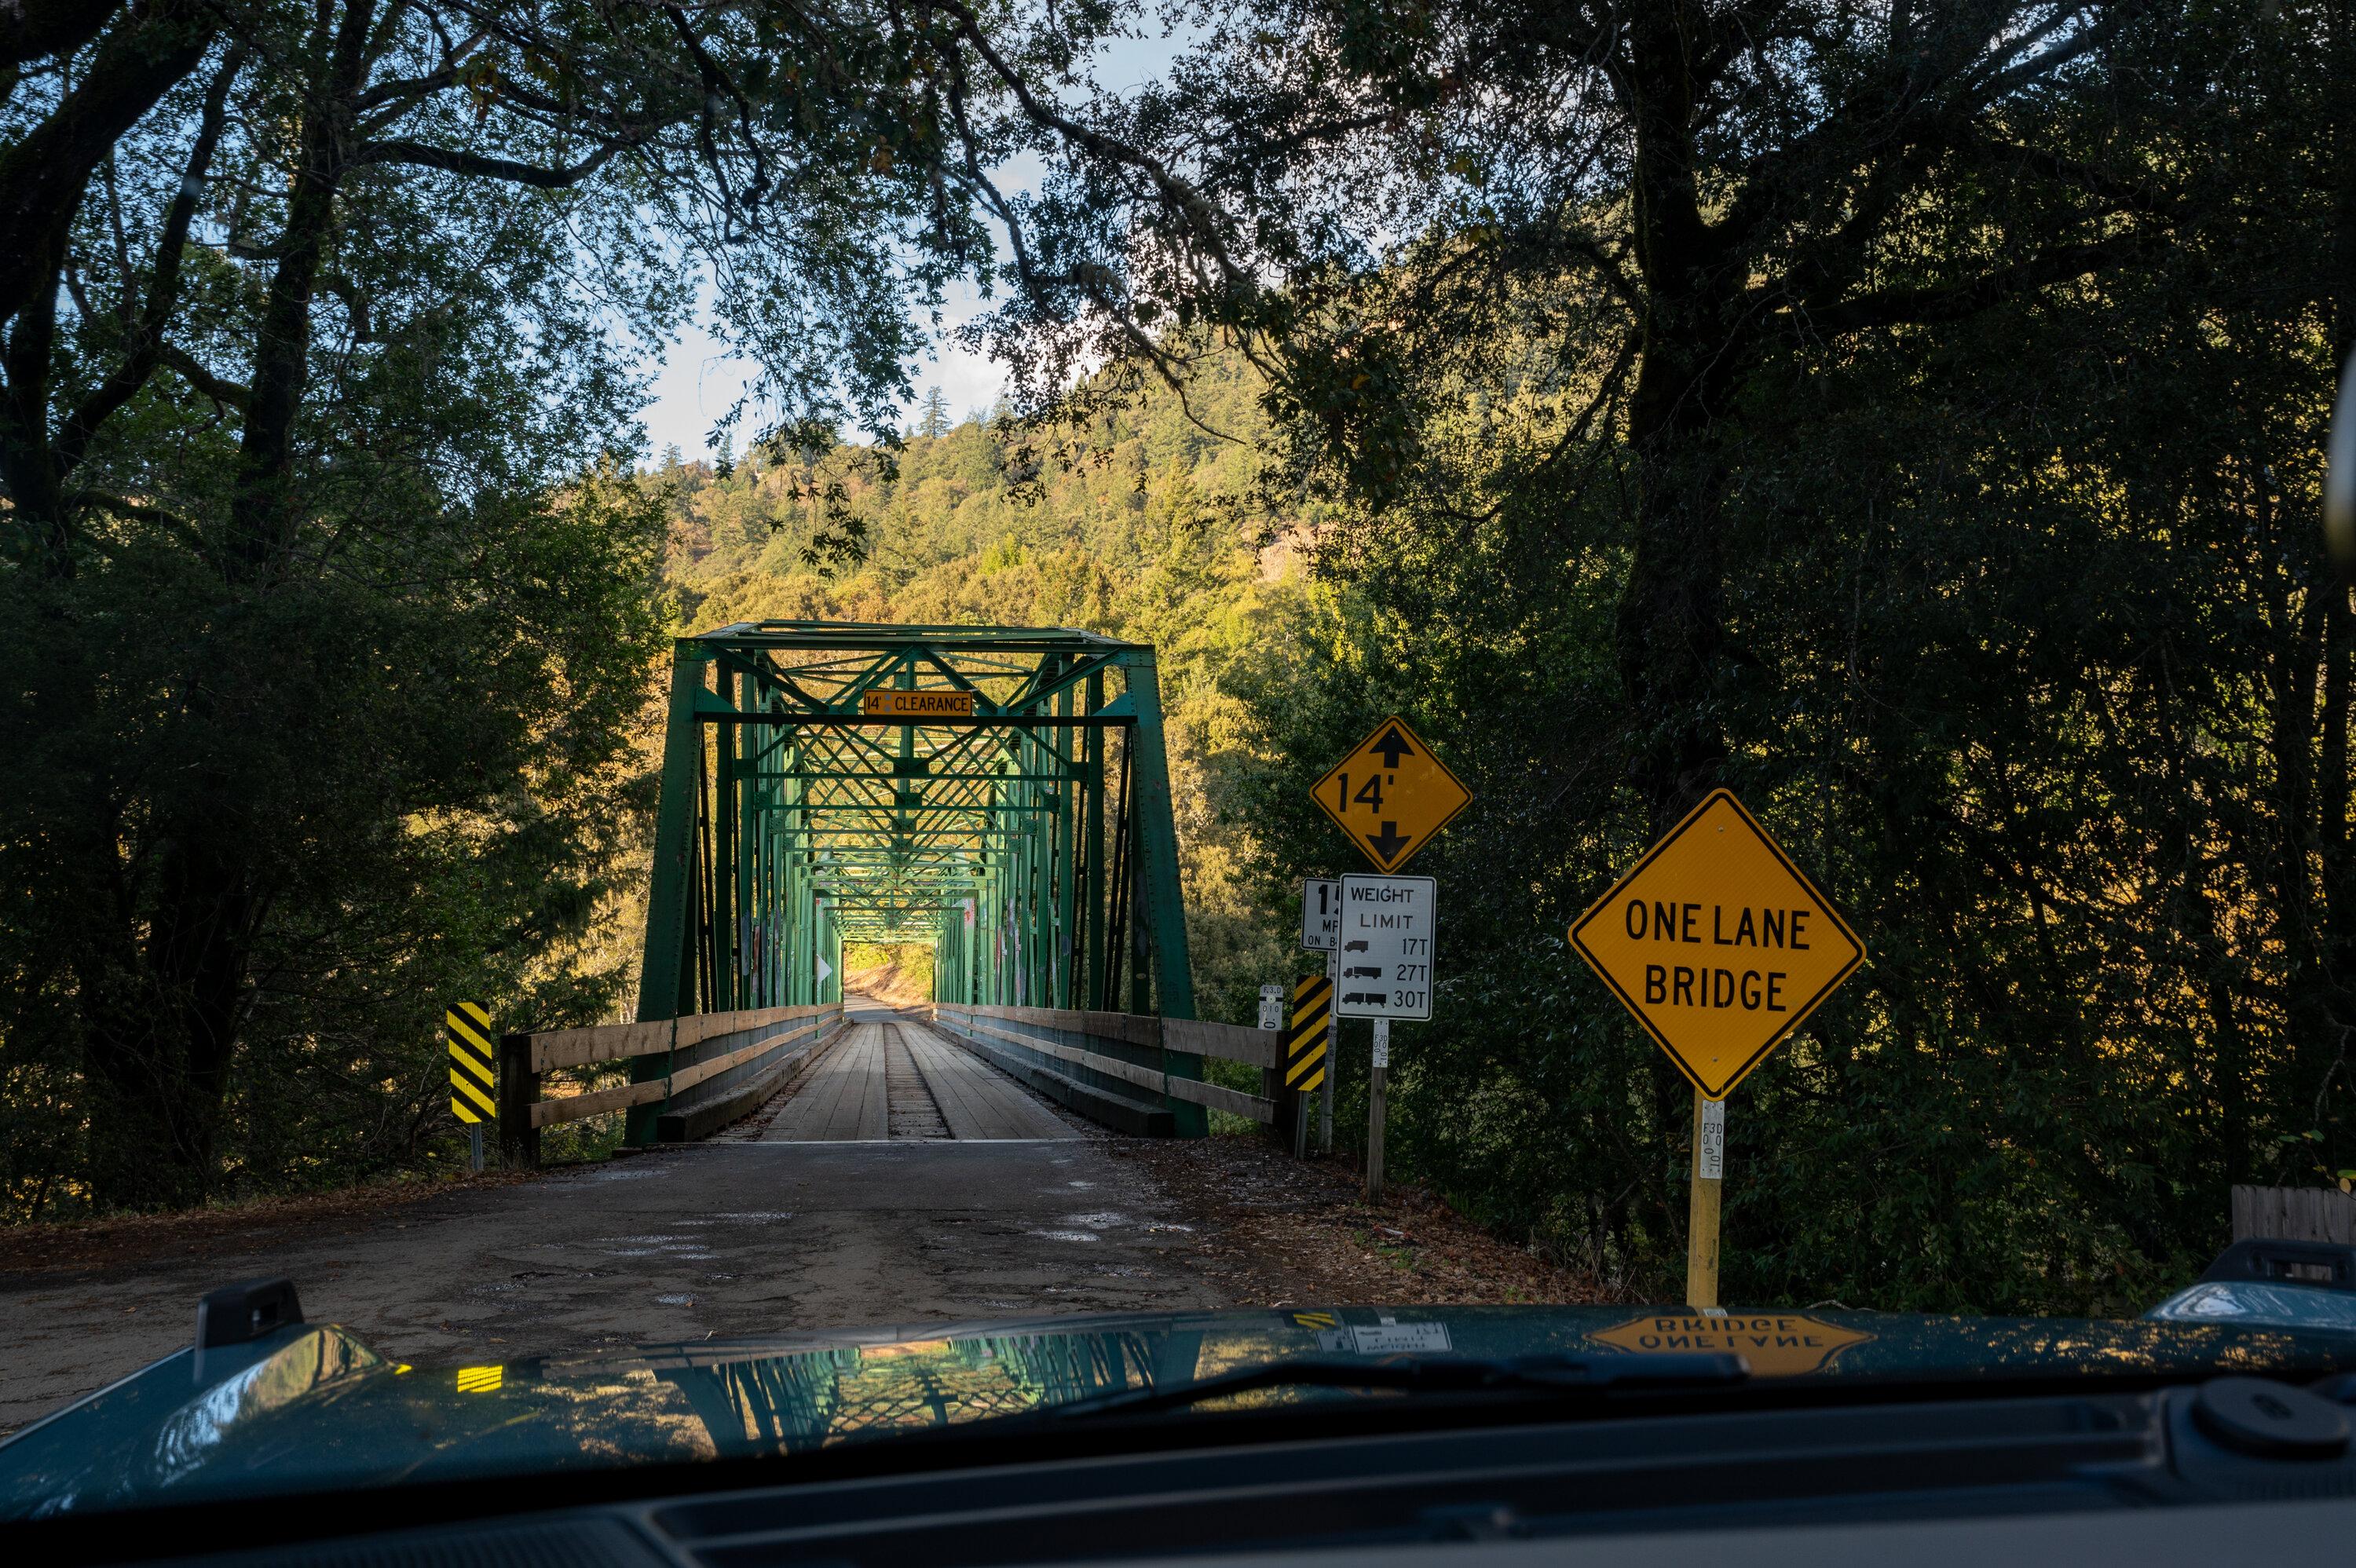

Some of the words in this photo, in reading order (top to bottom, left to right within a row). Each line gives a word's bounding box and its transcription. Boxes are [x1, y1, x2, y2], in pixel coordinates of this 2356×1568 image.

[867, 696, 881, 710] 14'
[895, 696, 968, 711] CLEARANCE
[1337, 773, 1394, 813] 14'
[1351, 887, 1414, 903] WEIGHT
[1323, 919, 1338, 933] MP
[1360, 914, 1413, 930] LIMIT
[1626, 899, 1701, 943] ONE
[1714, 905, 1810, 950] LANE
[1308, 935, 1320, 945] ON
[1402, 938, 1428, 956] 17T
[1397, 964, 1427, 981] 27T
[1645, 964, 1787, 1012] BRIDGE
[1393, 990, 1426, 1008] 30T
[1703, 1123, 1722, 1134] F3D
